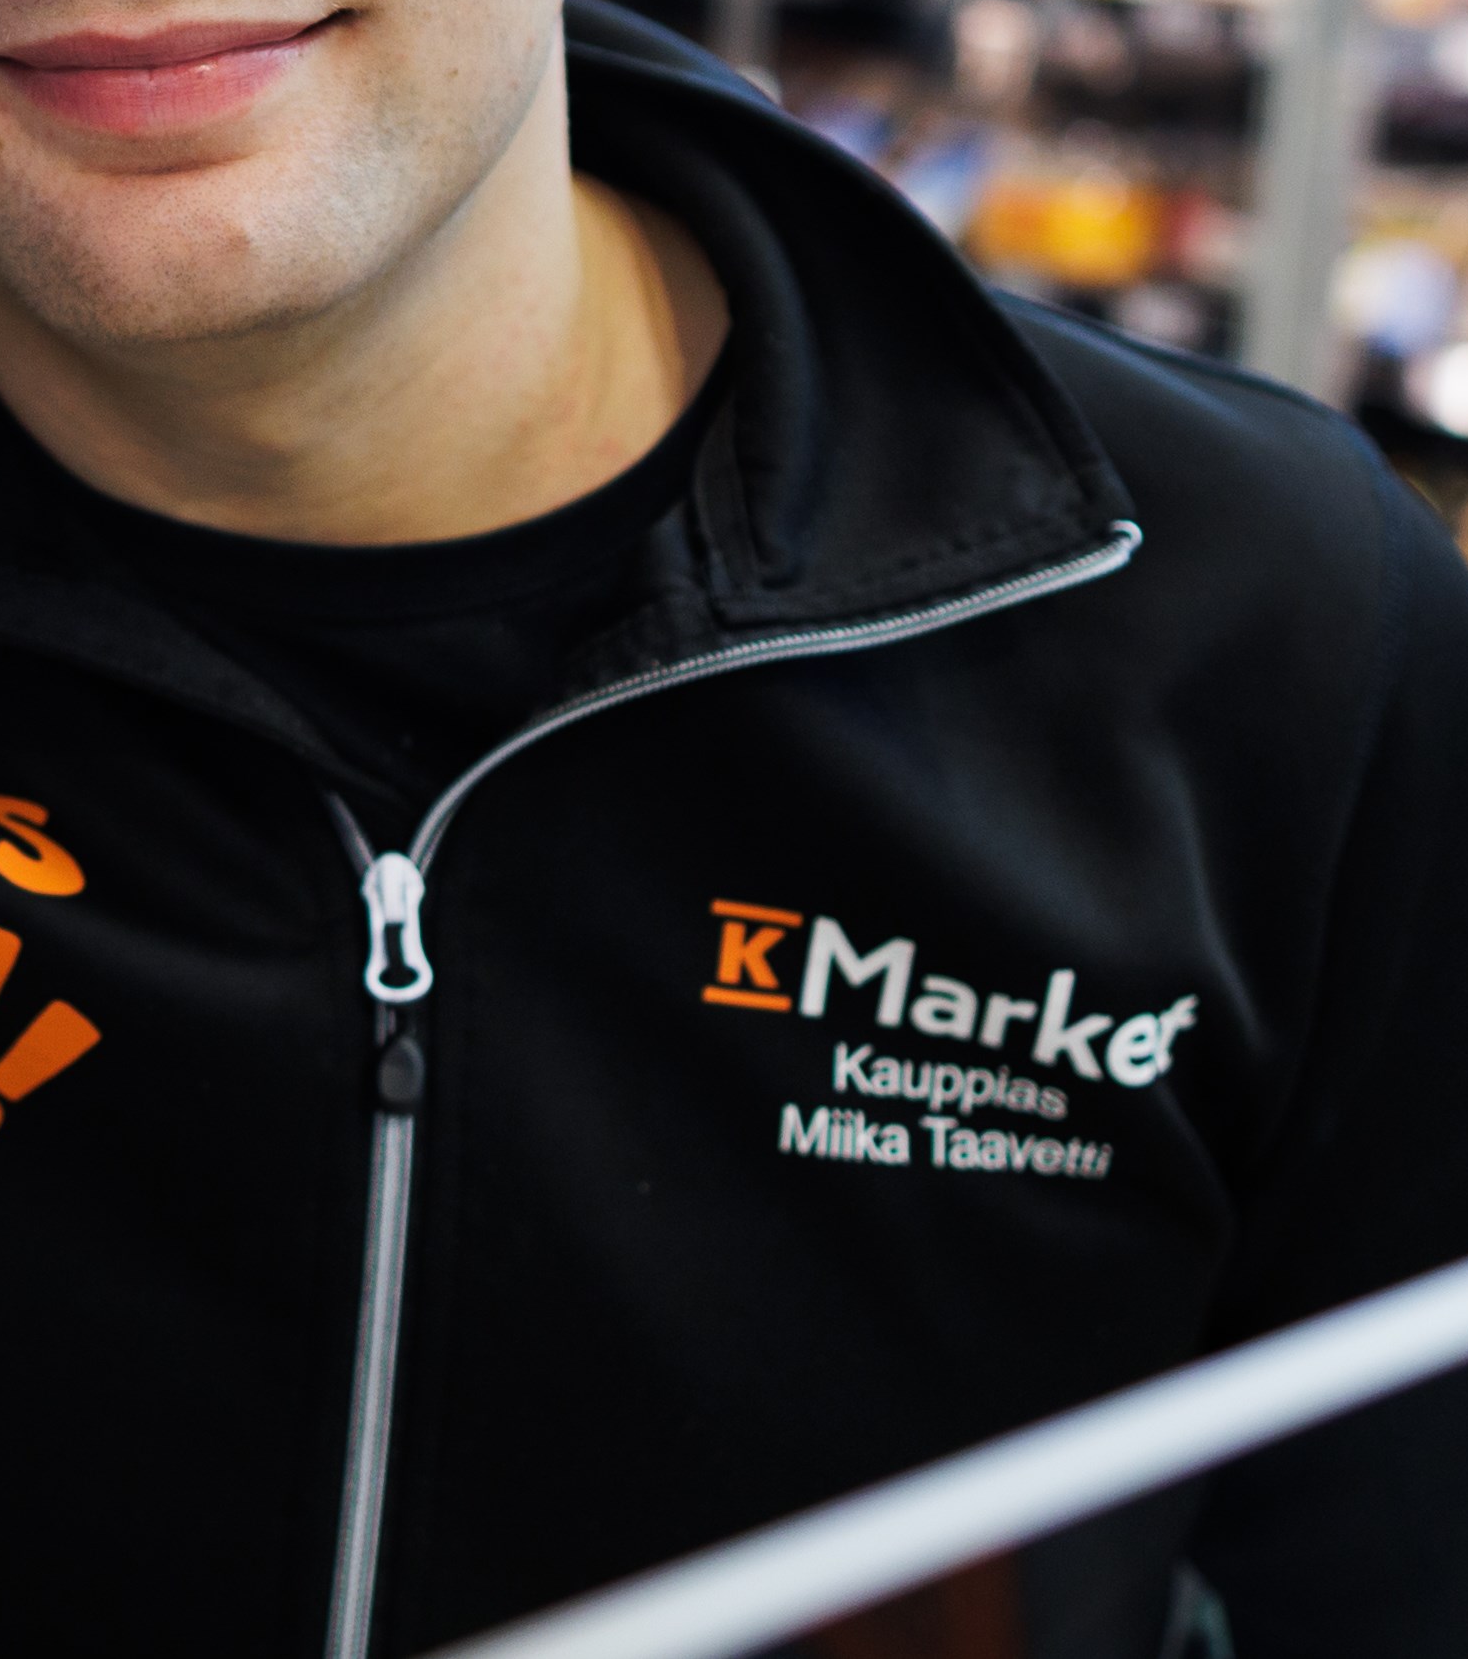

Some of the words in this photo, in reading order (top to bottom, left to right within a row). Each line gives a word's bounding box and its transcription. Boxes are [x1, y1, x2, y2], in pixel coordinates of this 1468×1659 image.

[833, 1042, 1069, 1121] Kauppias
[777, 1103, 911, 1167] Miika
[920, 1115, 1114, 1180] Taavetti
